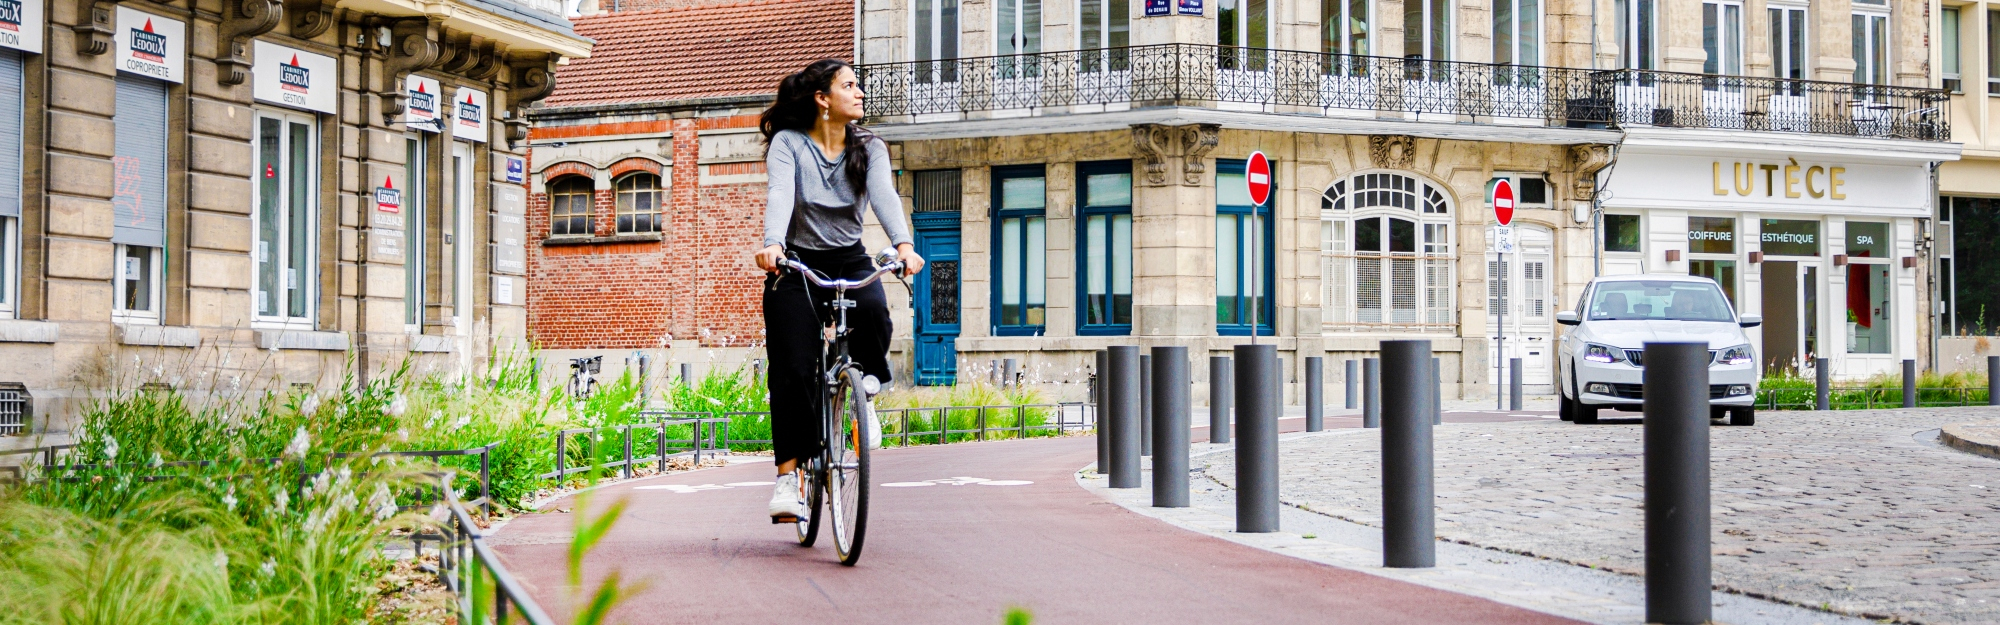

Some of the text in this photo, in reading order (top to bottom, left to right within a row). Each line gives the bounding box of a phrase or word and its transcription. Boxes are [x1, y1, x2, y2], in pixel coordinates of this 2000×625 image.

[131, 31, 165, 55] LEDOUX
[135, 31, 157, 42] CABINET
[126, 59, 169, 77] COPROPRIETE
[283, 65, 302, 75] CABINET
[281, 66, 309, 86] LEDOUX
[283, 92, 306, 105] GESTION
[410, 93, 434, 110] LEDOUX
[412, 92, 428, 100] CABINET
[460, 104, 480, 121] LEDOUX
[461, 104, 475, 112] CABINET
[1713, 157, 1846, 199] LUTÈCE
[377, 189, 400, 205] LEDOUX
[1688, 231, 1732, 241] COIFFURE
[1762, 232, 1814, 244] ESTHÉTIQUE
[1857, 235, 1873, 245] SPA
